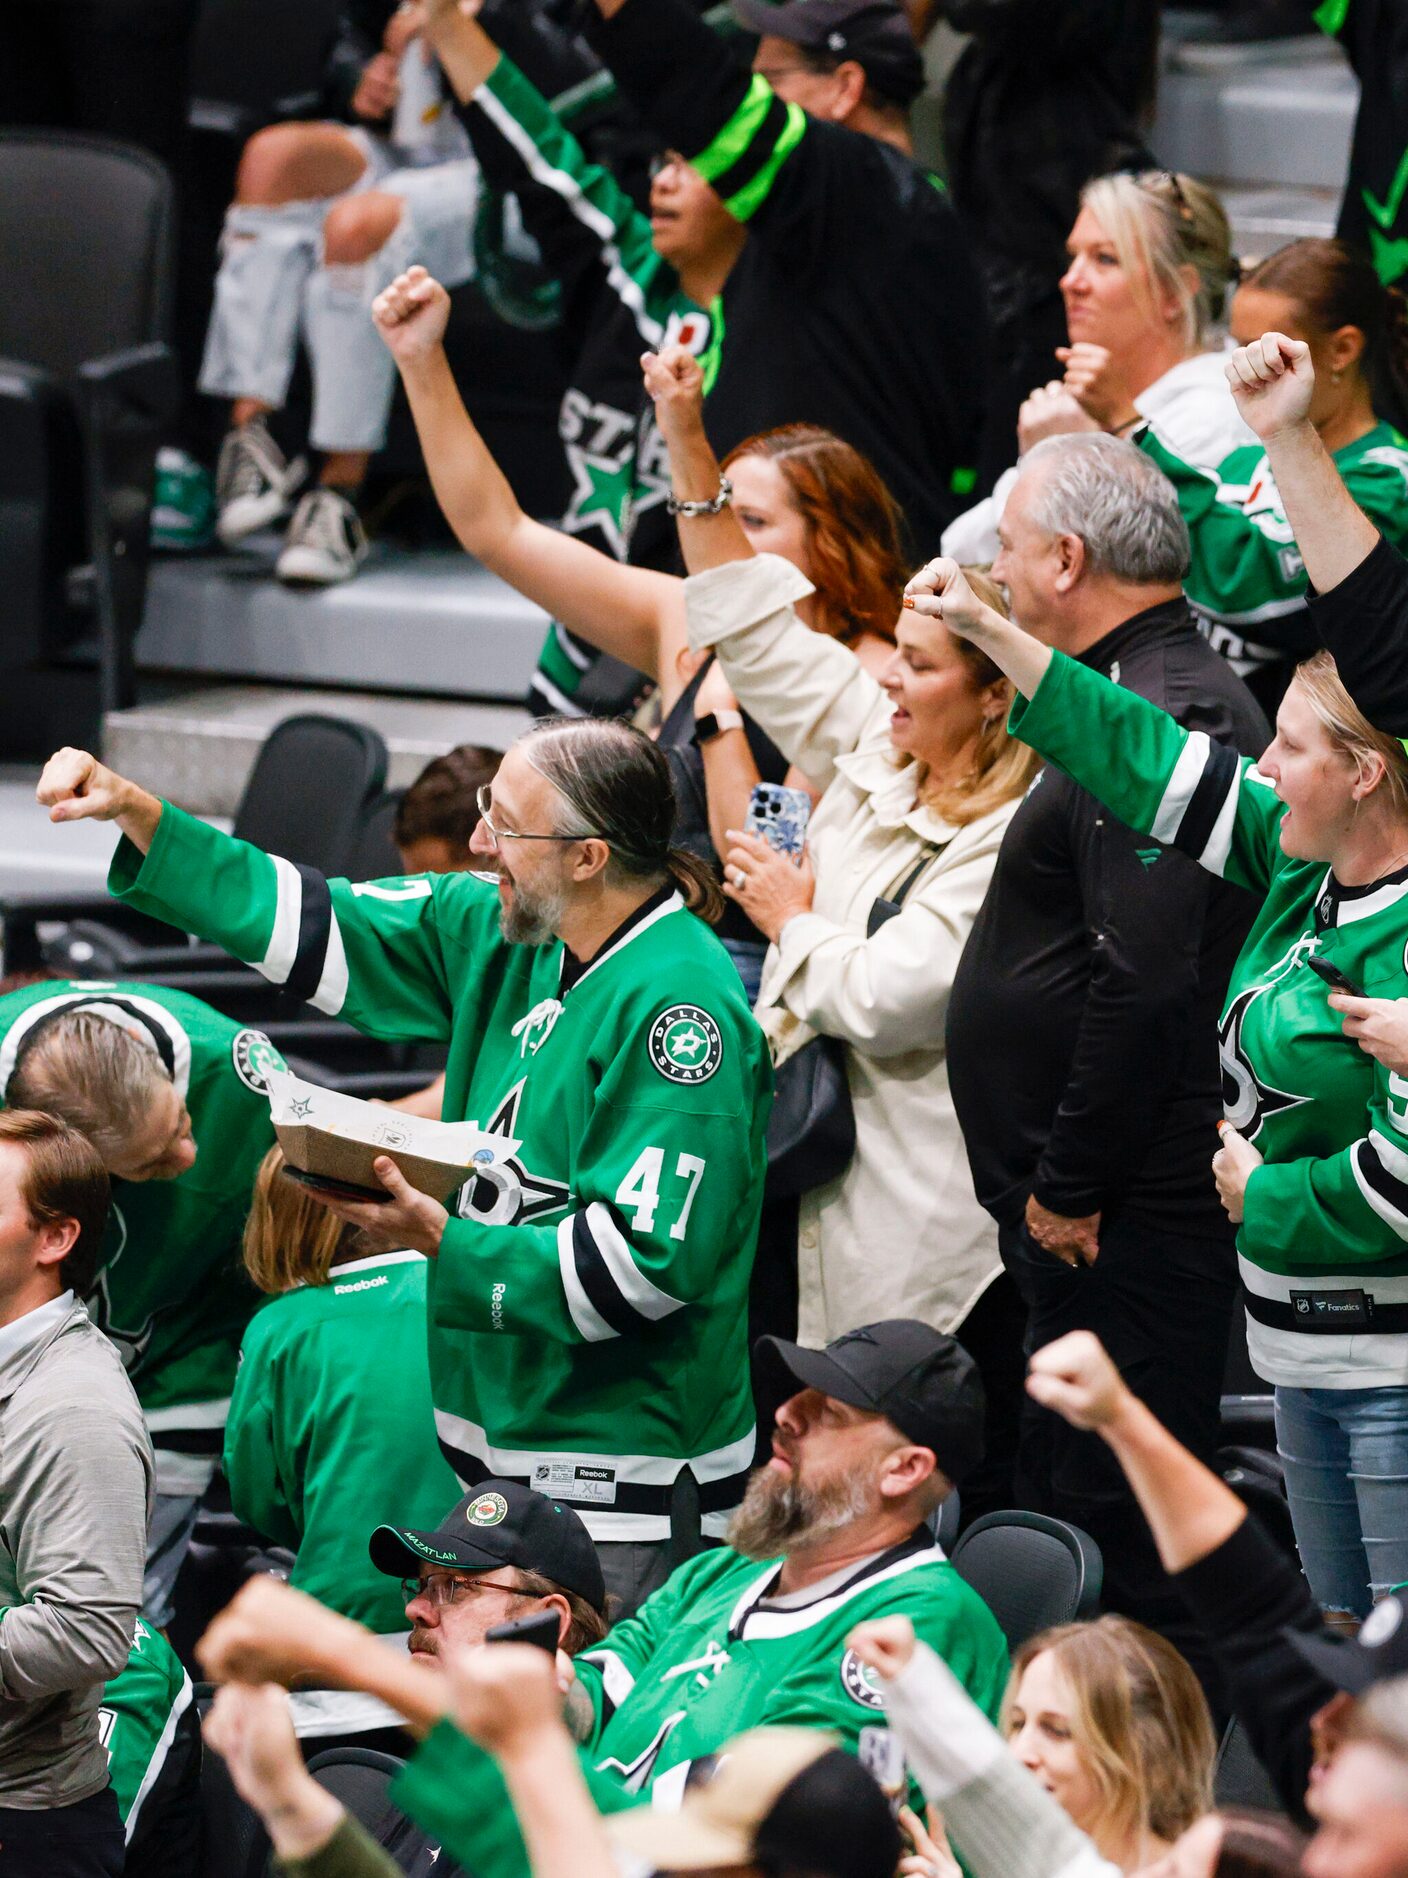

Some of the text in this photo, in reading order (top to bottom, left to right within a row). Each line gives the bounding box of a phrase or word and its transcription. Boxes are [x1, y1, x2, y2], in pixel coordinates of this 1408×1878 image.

[654, 1010, 718, 1043] DALLAS
[658, 1055, 714, 1078] STARS
[615, 1146, 706, 1242] 47
[334, 1275, 390, 1295] Reebok
[491, 1283, 506, 1330] Reebok
[1327, 1303, 1360, 1311] Fanatics
[580, 1469, 608, 1479] Reebok
[582, 1482, 602, 1495] XL
